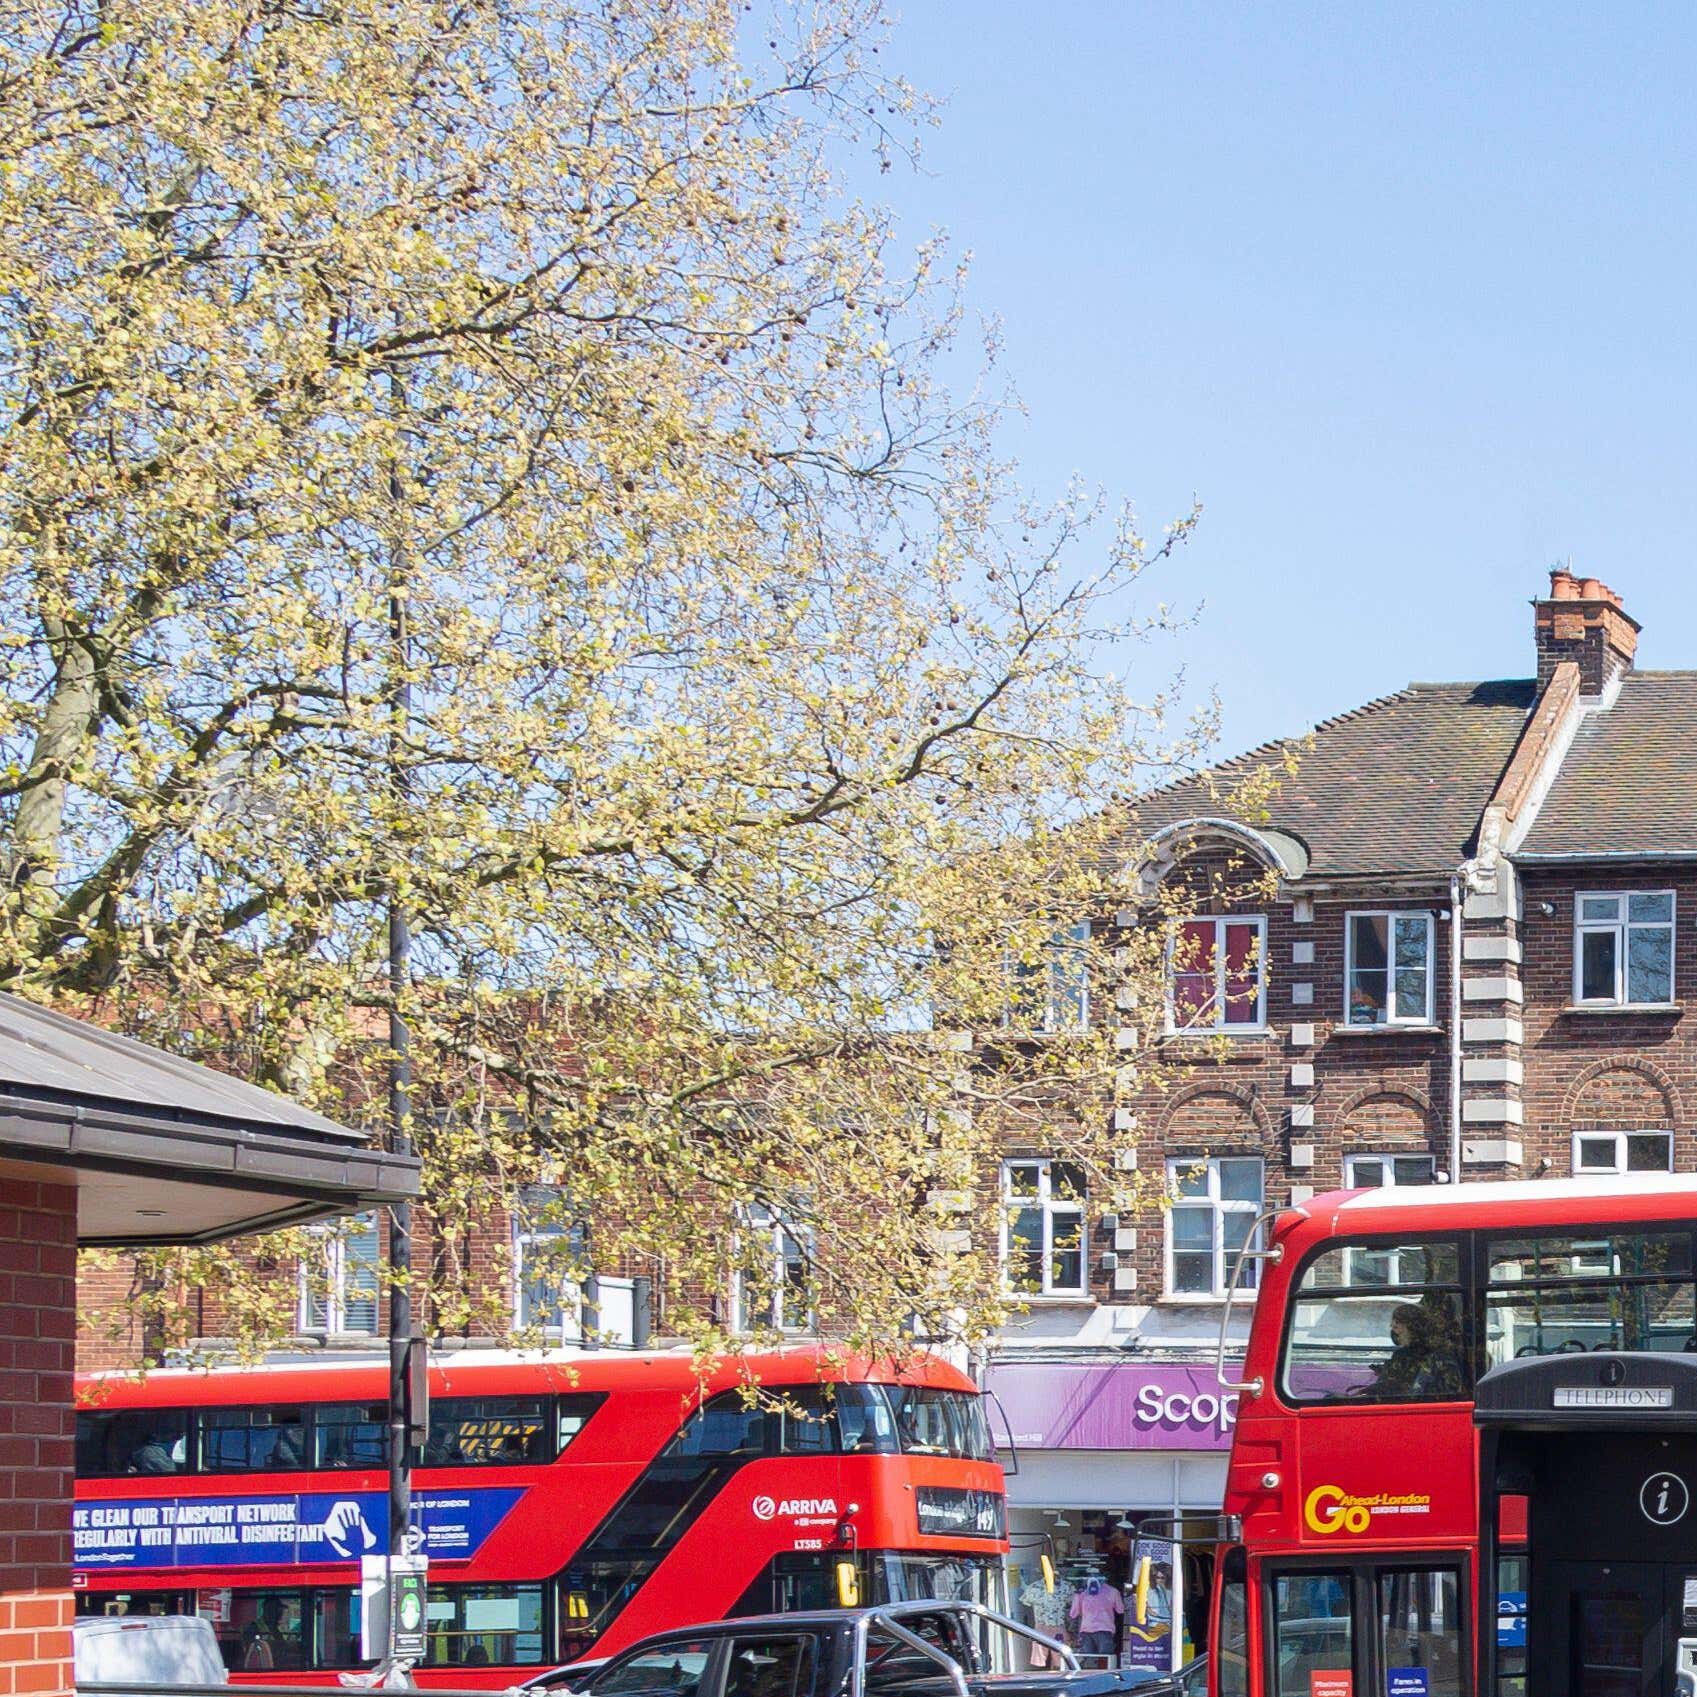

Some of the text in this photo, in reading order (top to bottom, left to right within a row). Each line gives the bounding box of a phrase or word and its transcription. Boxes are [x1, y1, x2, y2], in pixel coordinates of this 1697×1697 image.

[1564, 1389, 1667, 1405] TELEPHONE
[1137, 1384, 1241, 1432] Scop
[437, 1499, 470, 1508] LONDON
[778, 1499, 837, 1515] ARRIVA
[1304, 1485, 1371, 1534] Go
[91, 1507, 129, 1528] CLEAN
[132, 1506, 158, 1526] OUR
[162, 1505, 235, 1525] TRANSPORT
[237, 1503, 296, 1524] NETWORK
[141, 1527, 171, 1546] WITH
[175, 1525, 238, 1545] ANTIVIRAL
[242, 1523, 326, 1543] DISINFECTANT
[428, 1525, 465, 1533] TRANSPORT
[440, 1532, 469, 1540] LONDON
[794, 1539, 822, 1550] LT585
[74, 1552, 135, 1563] LondonTogether
